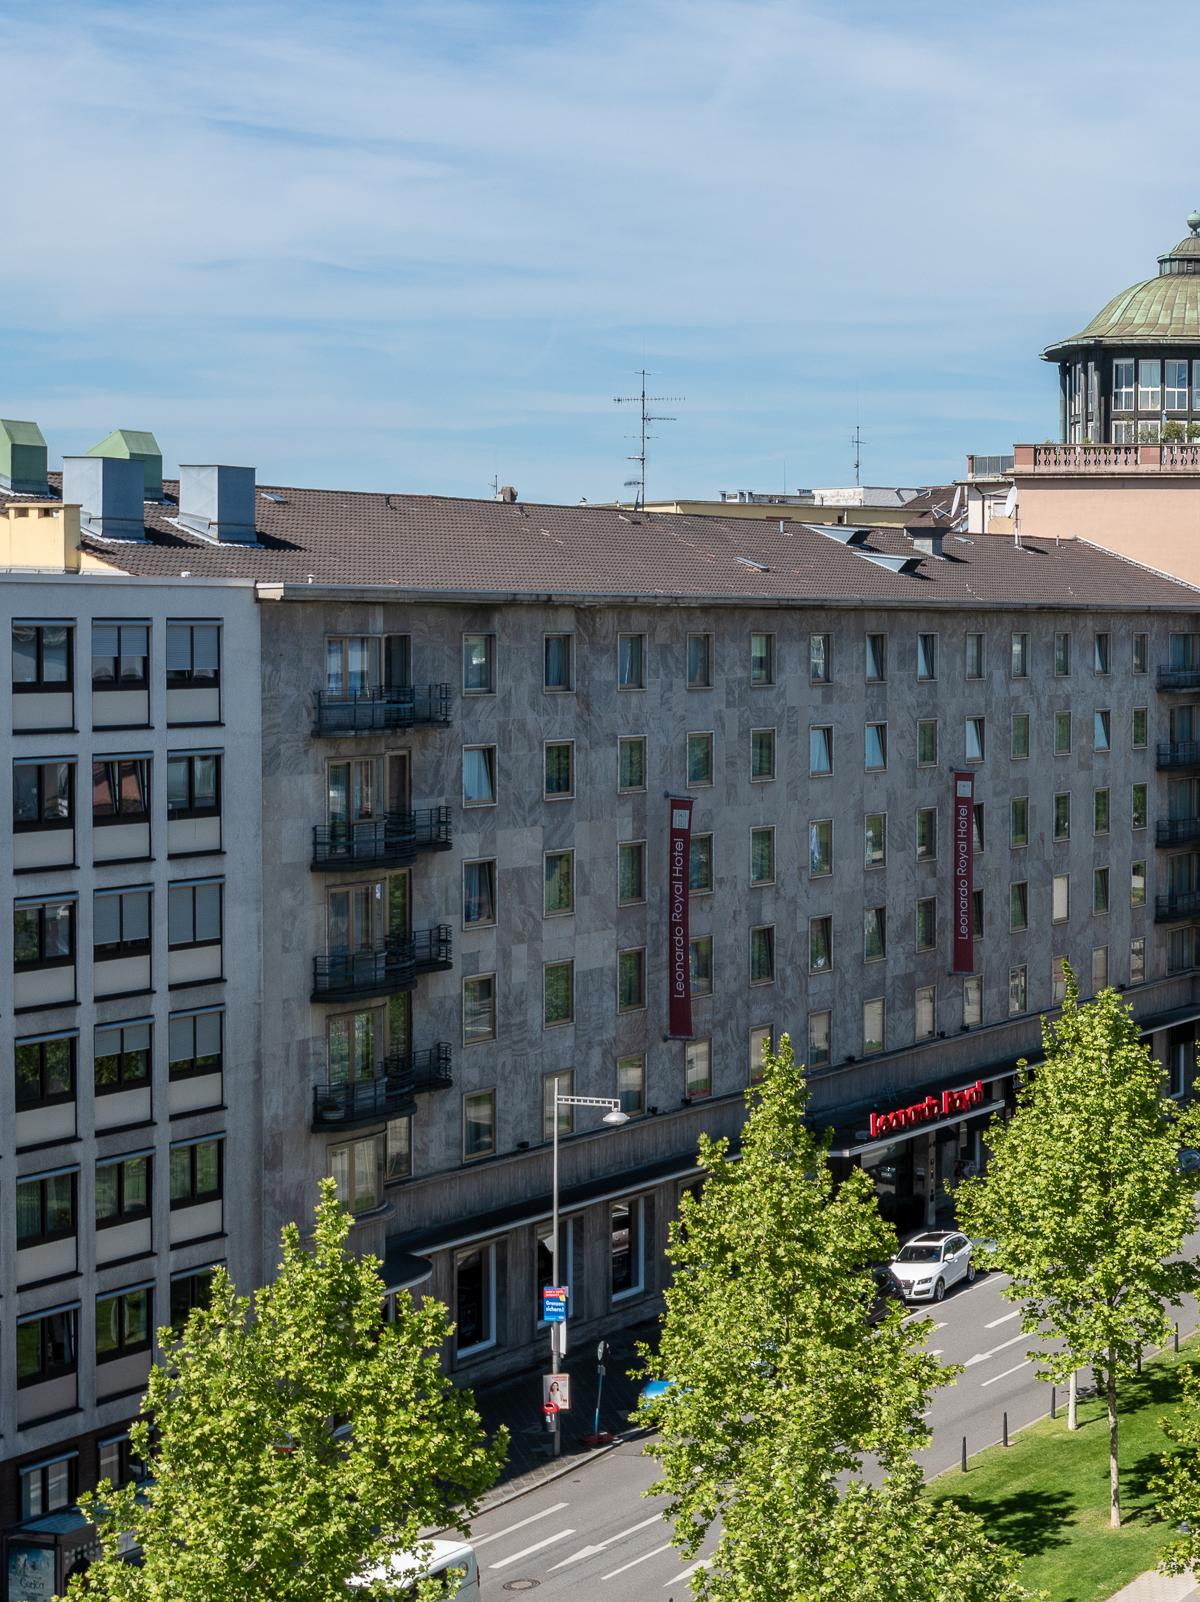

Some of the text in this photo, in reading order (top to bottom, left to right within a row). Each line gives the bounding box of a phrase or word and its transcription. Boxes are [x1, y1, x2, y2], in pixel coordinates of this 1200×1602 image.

[671, 837, 685, 998] Leonardo Royal Hotel
[956, 805, 968, 940] Leonardo Royal Hotel
[870, 1079, 983, 1137] Leonardo Royal
